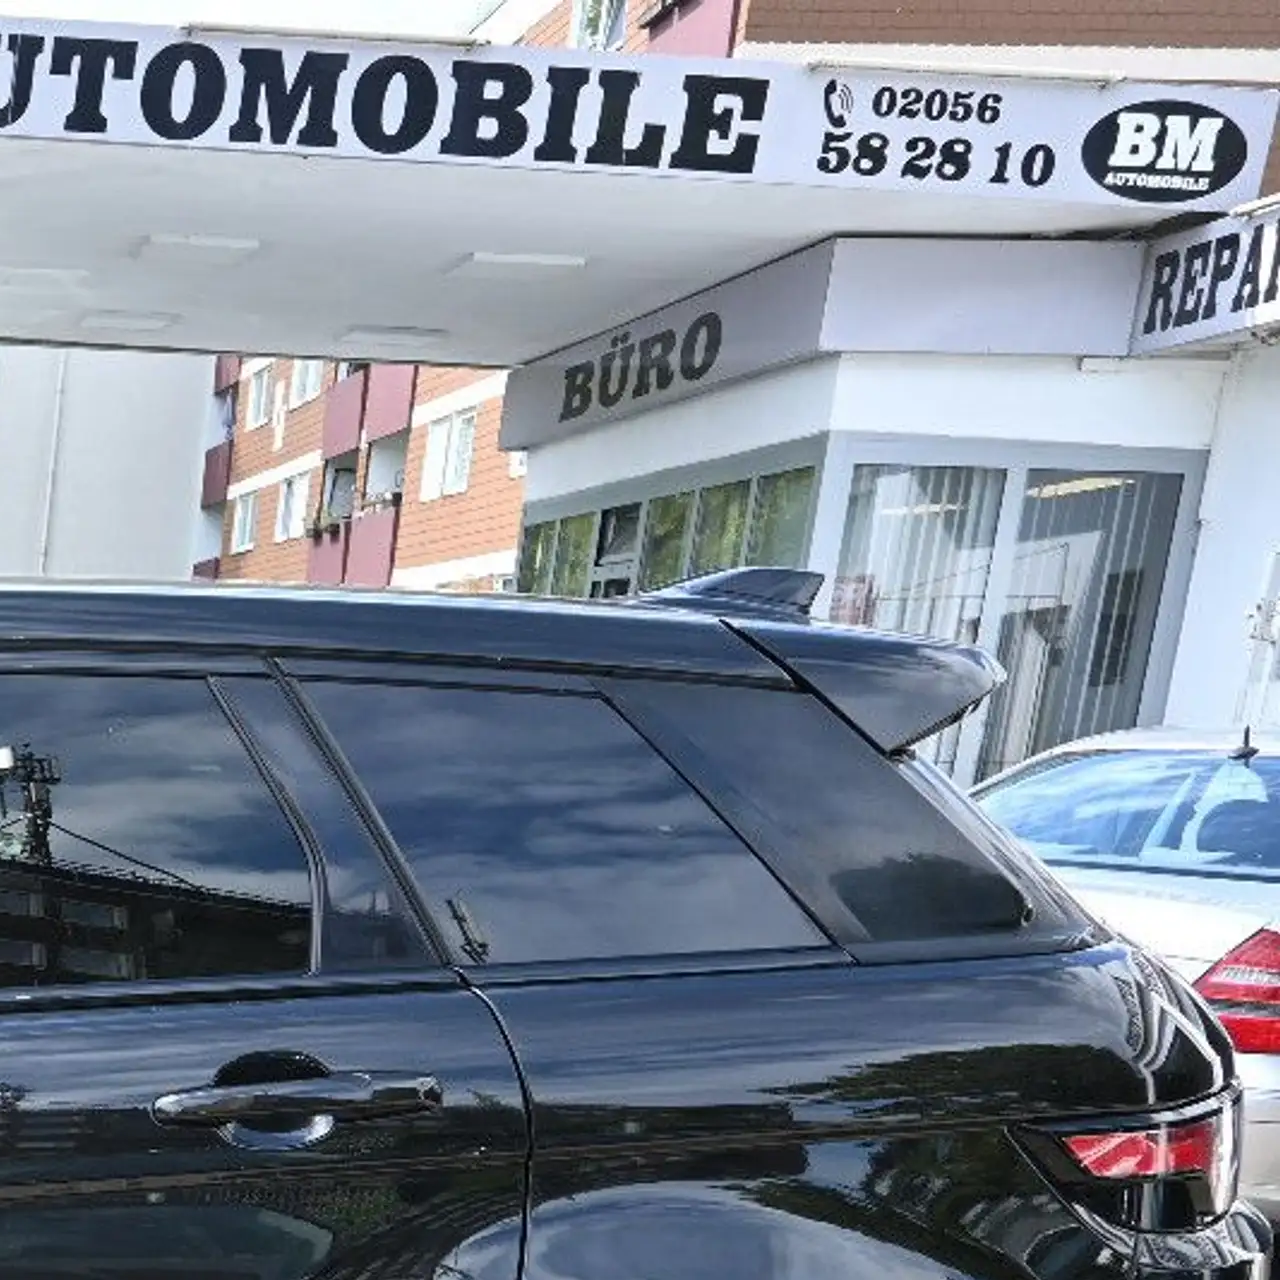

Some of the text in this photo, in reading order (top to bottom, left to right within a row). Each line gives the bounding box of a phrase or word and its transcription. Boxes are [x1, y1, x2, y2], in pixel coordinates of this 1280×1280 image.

[872, 86, 1004, 124] 02056
[816, 131, 1057, 188] 58 28 10
[1108, 112, 1224, 173] BM
[1103, 171, 1210, 192] AUTOMOBILE
[558, 311, 723, 423] BÜRO
